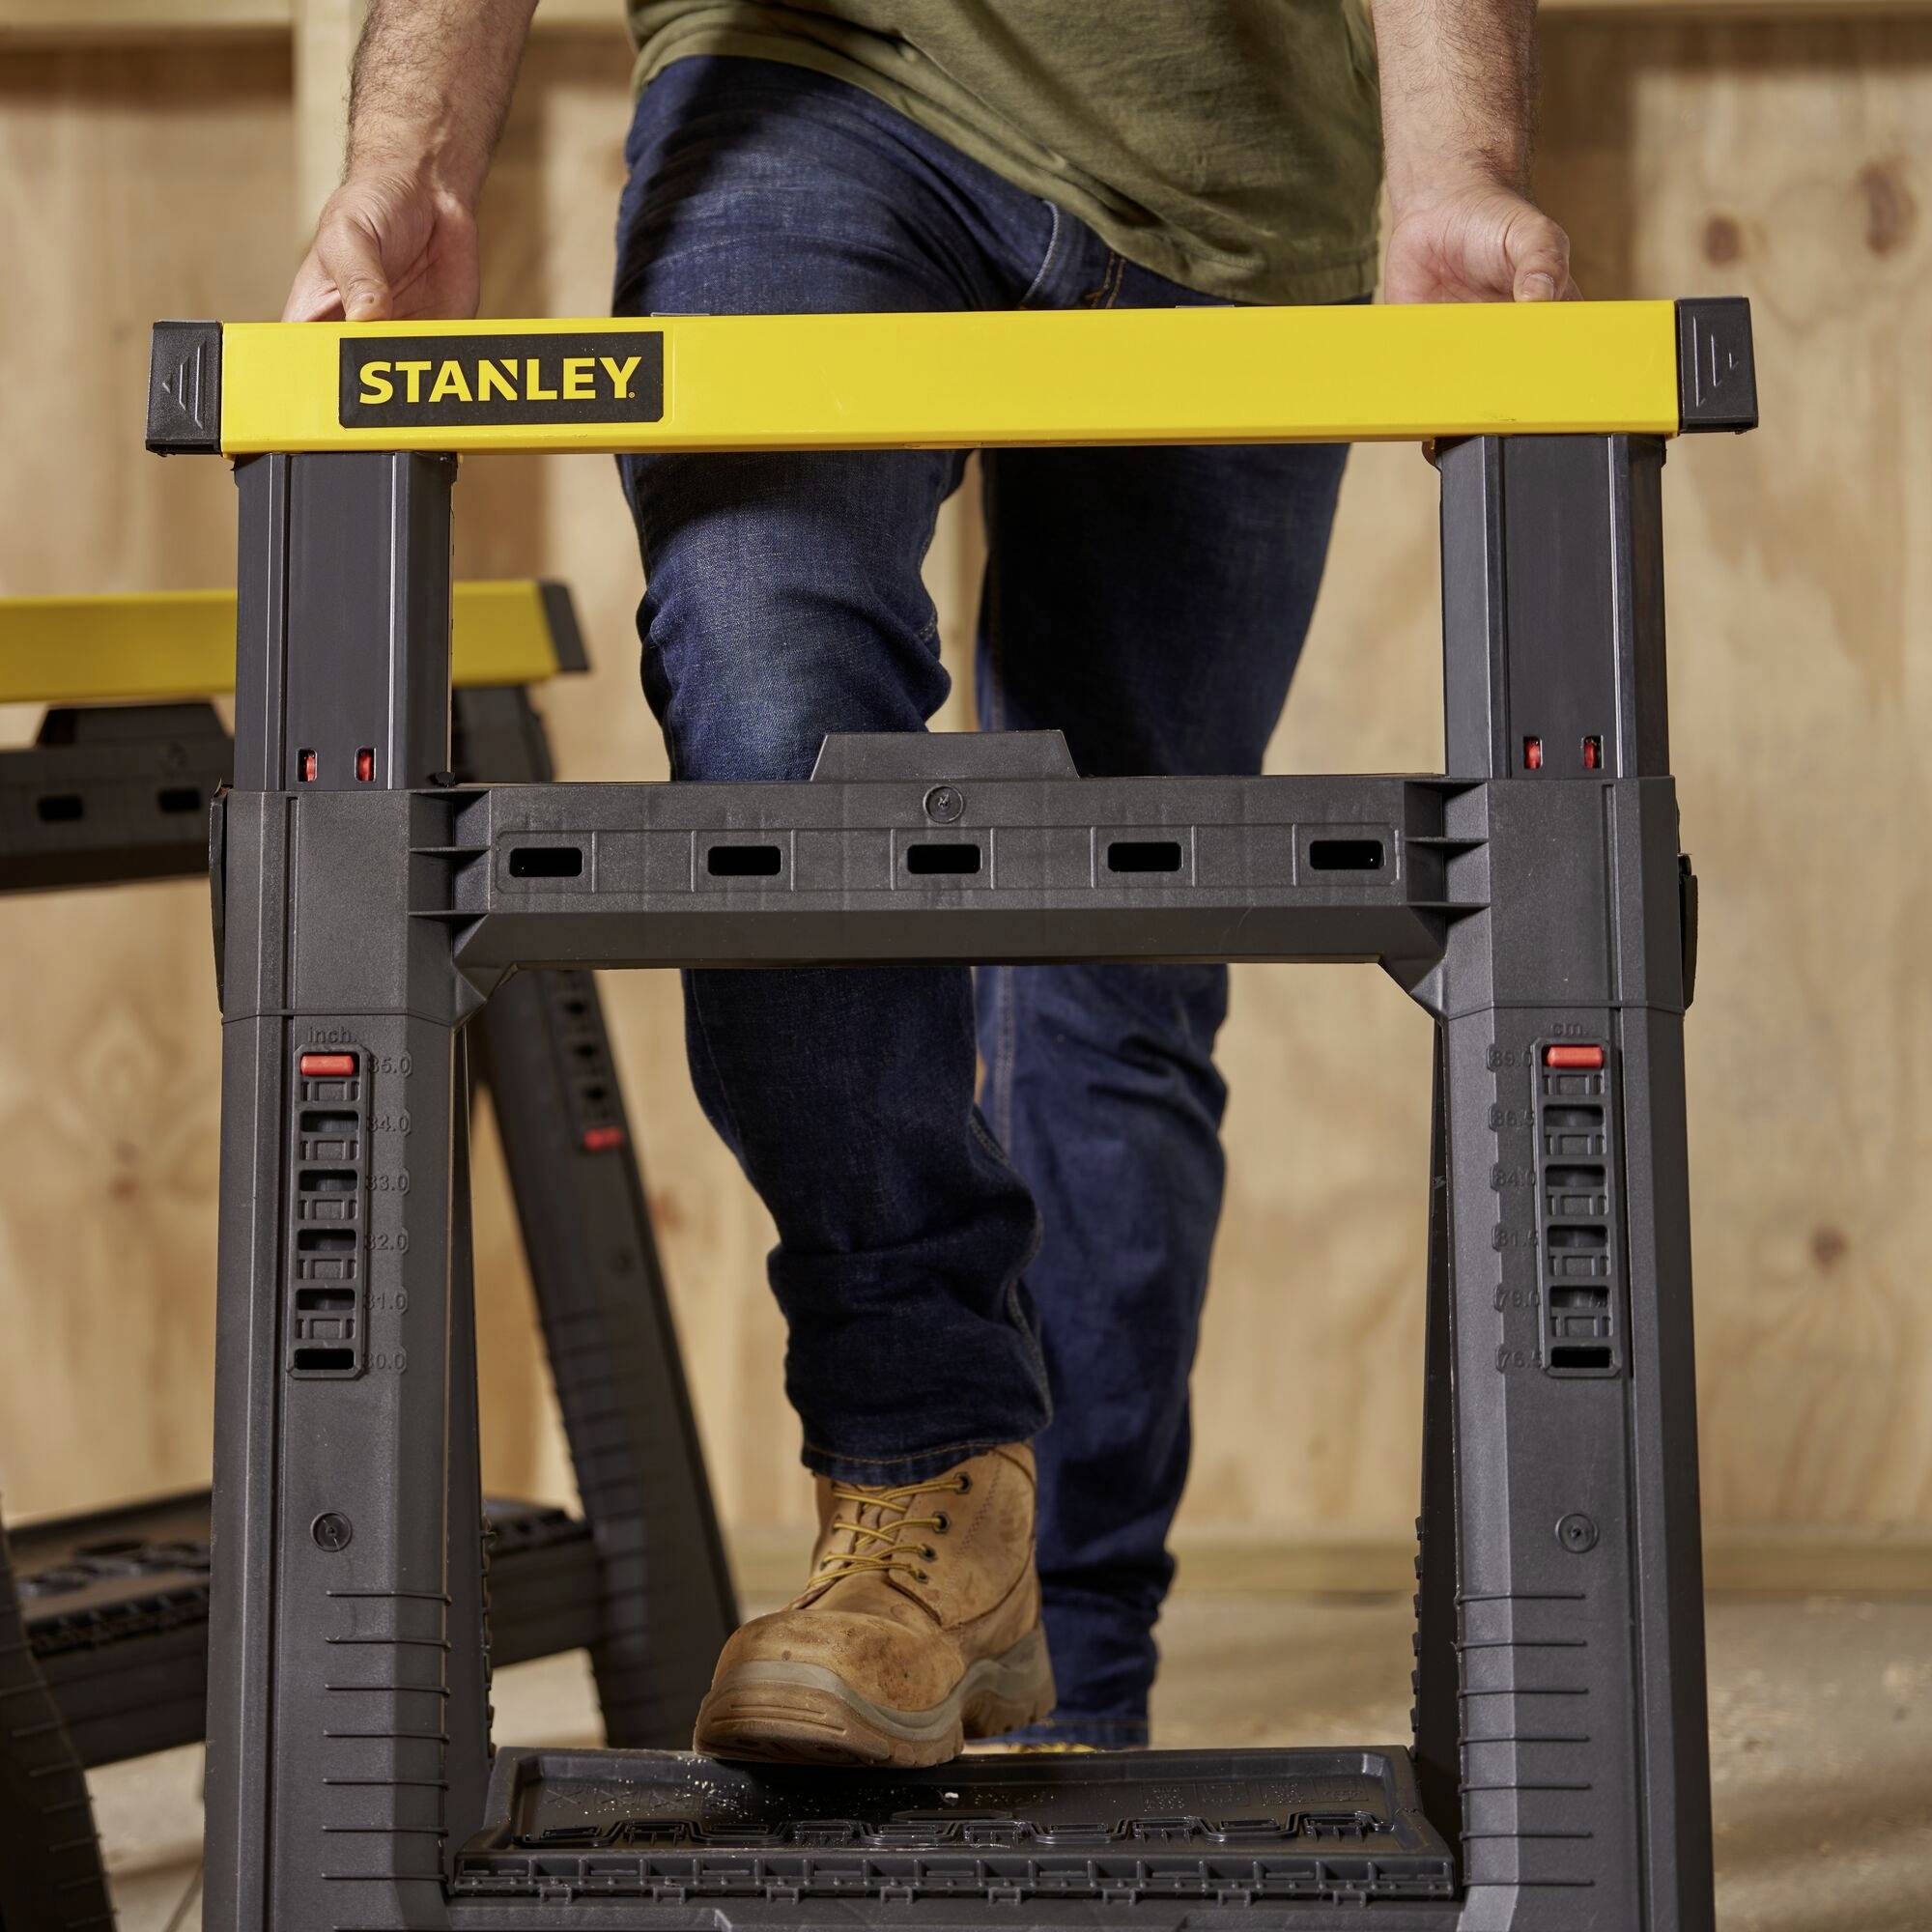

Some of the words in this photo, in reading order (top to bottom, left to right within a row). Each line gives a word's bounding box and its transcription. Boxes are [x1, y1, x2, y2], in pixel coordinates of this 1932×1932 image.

[358, 356, 642, 405] STANLEY
[368, 1057, 411, 1074] 35.0
[367, 1116, 410, 1132] 34.0
[366, 1175, 409, 1191] 33.0
[365, 1235, 408, 1251] 32.0
